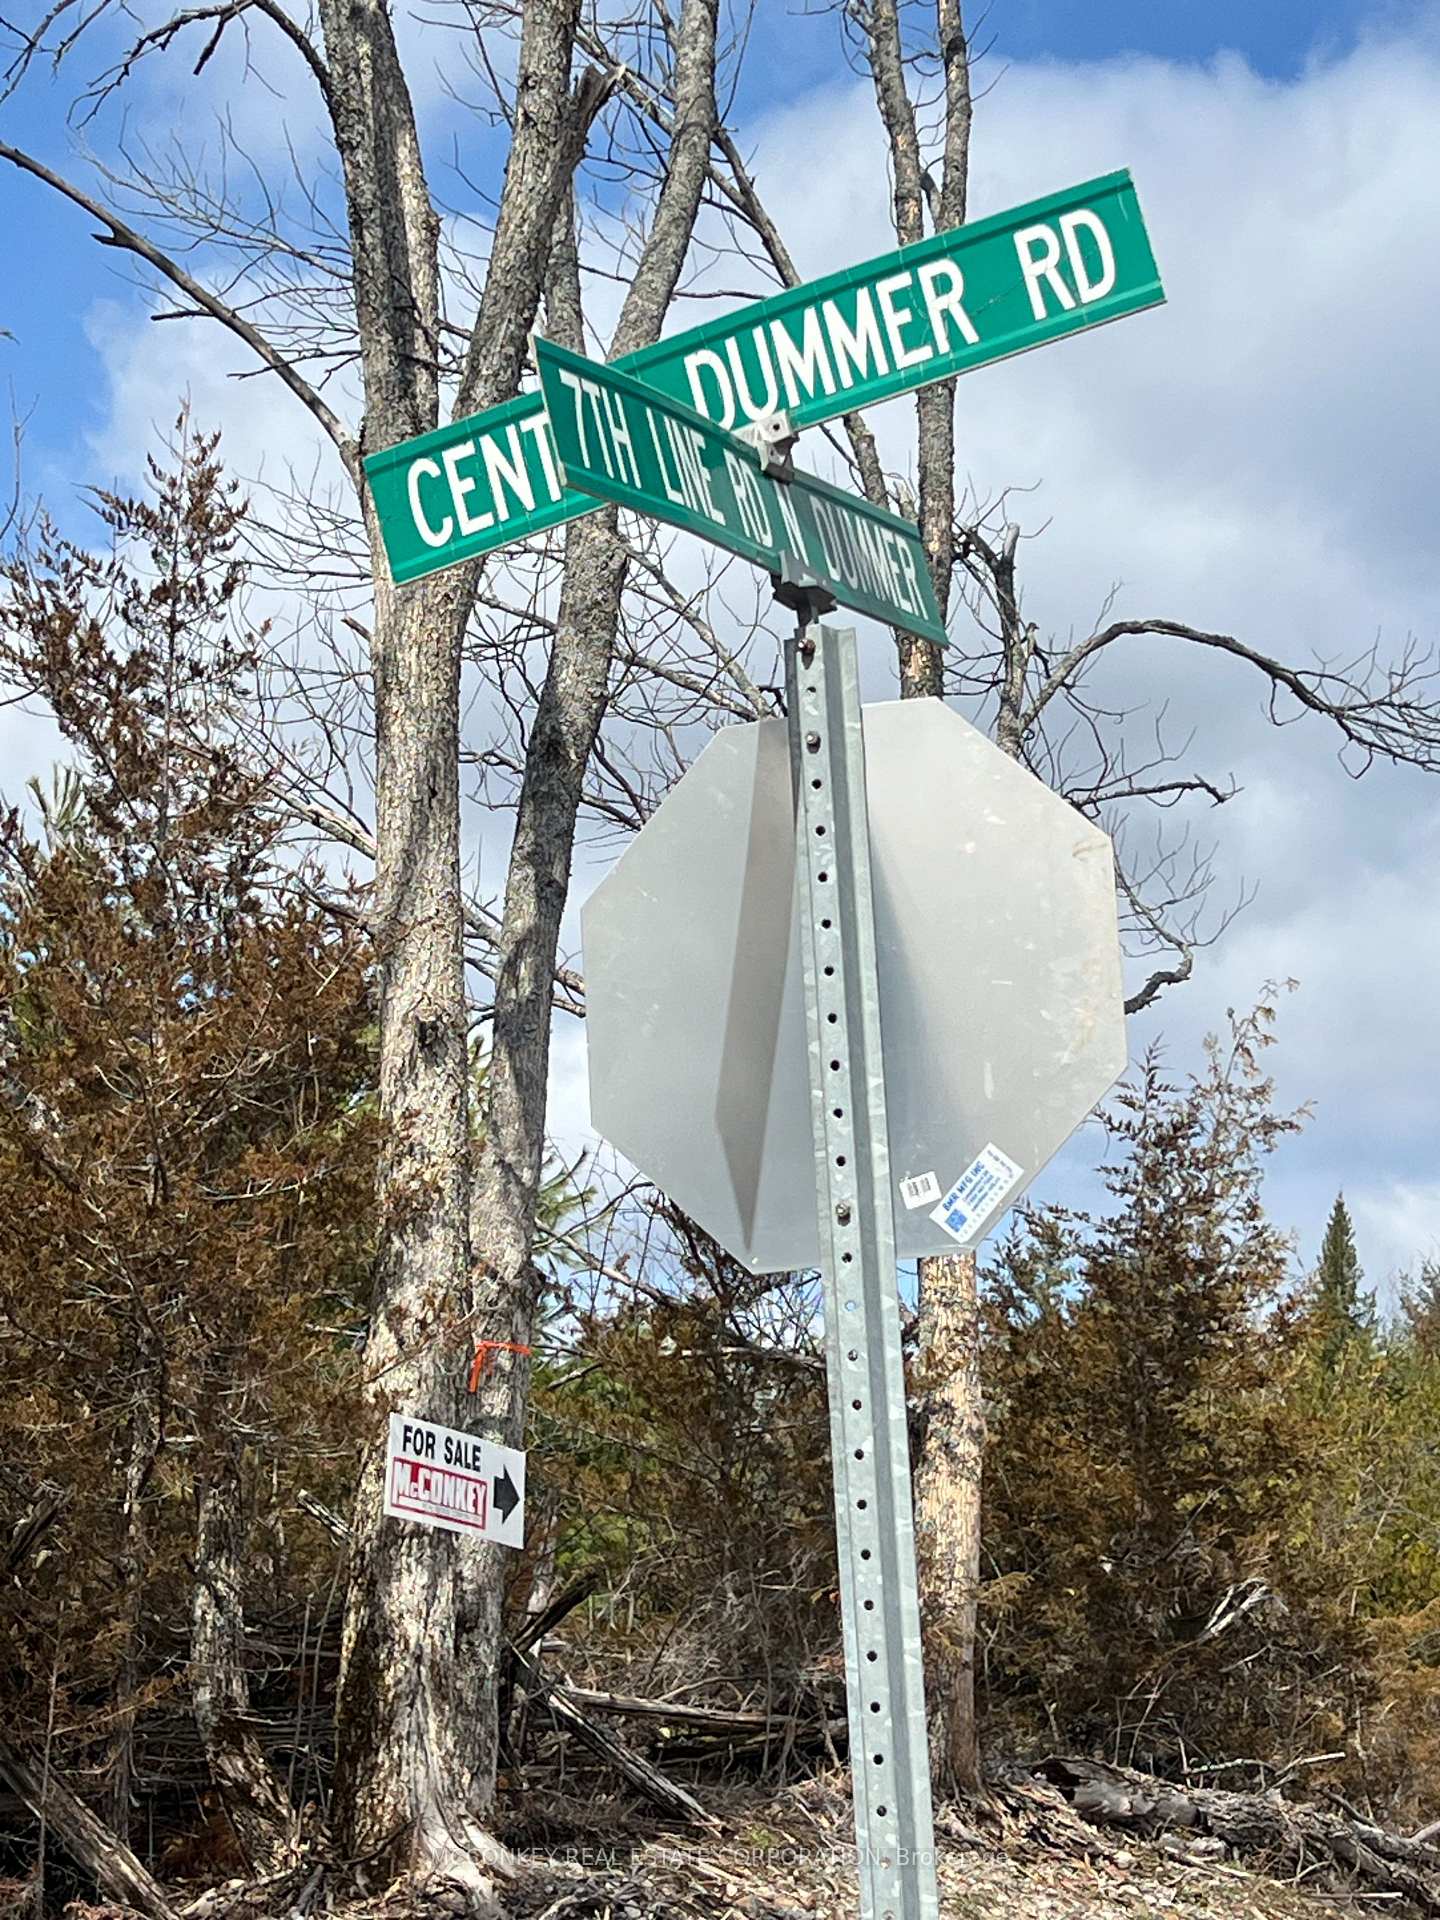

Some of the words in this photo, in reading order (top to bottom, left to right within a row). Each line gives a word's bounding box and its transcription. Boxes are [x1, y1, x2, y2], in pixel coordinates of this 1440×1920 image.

[407, 410, 562, 548] CENT
[684, 257, 979, 431] DUMMER
[1013, 208, 1116, 321] RD
[558, 367, 642, 490] 7TH
[645, 406, 726, 527] LINE
[723, 447, 774, 549] RD
[772, 480, 810, 567] N
[809, 494, 929, 621] DUMMER
[402, 1424, 436, 1460] FOR
[444, 1435, 481, 1472] SALE
